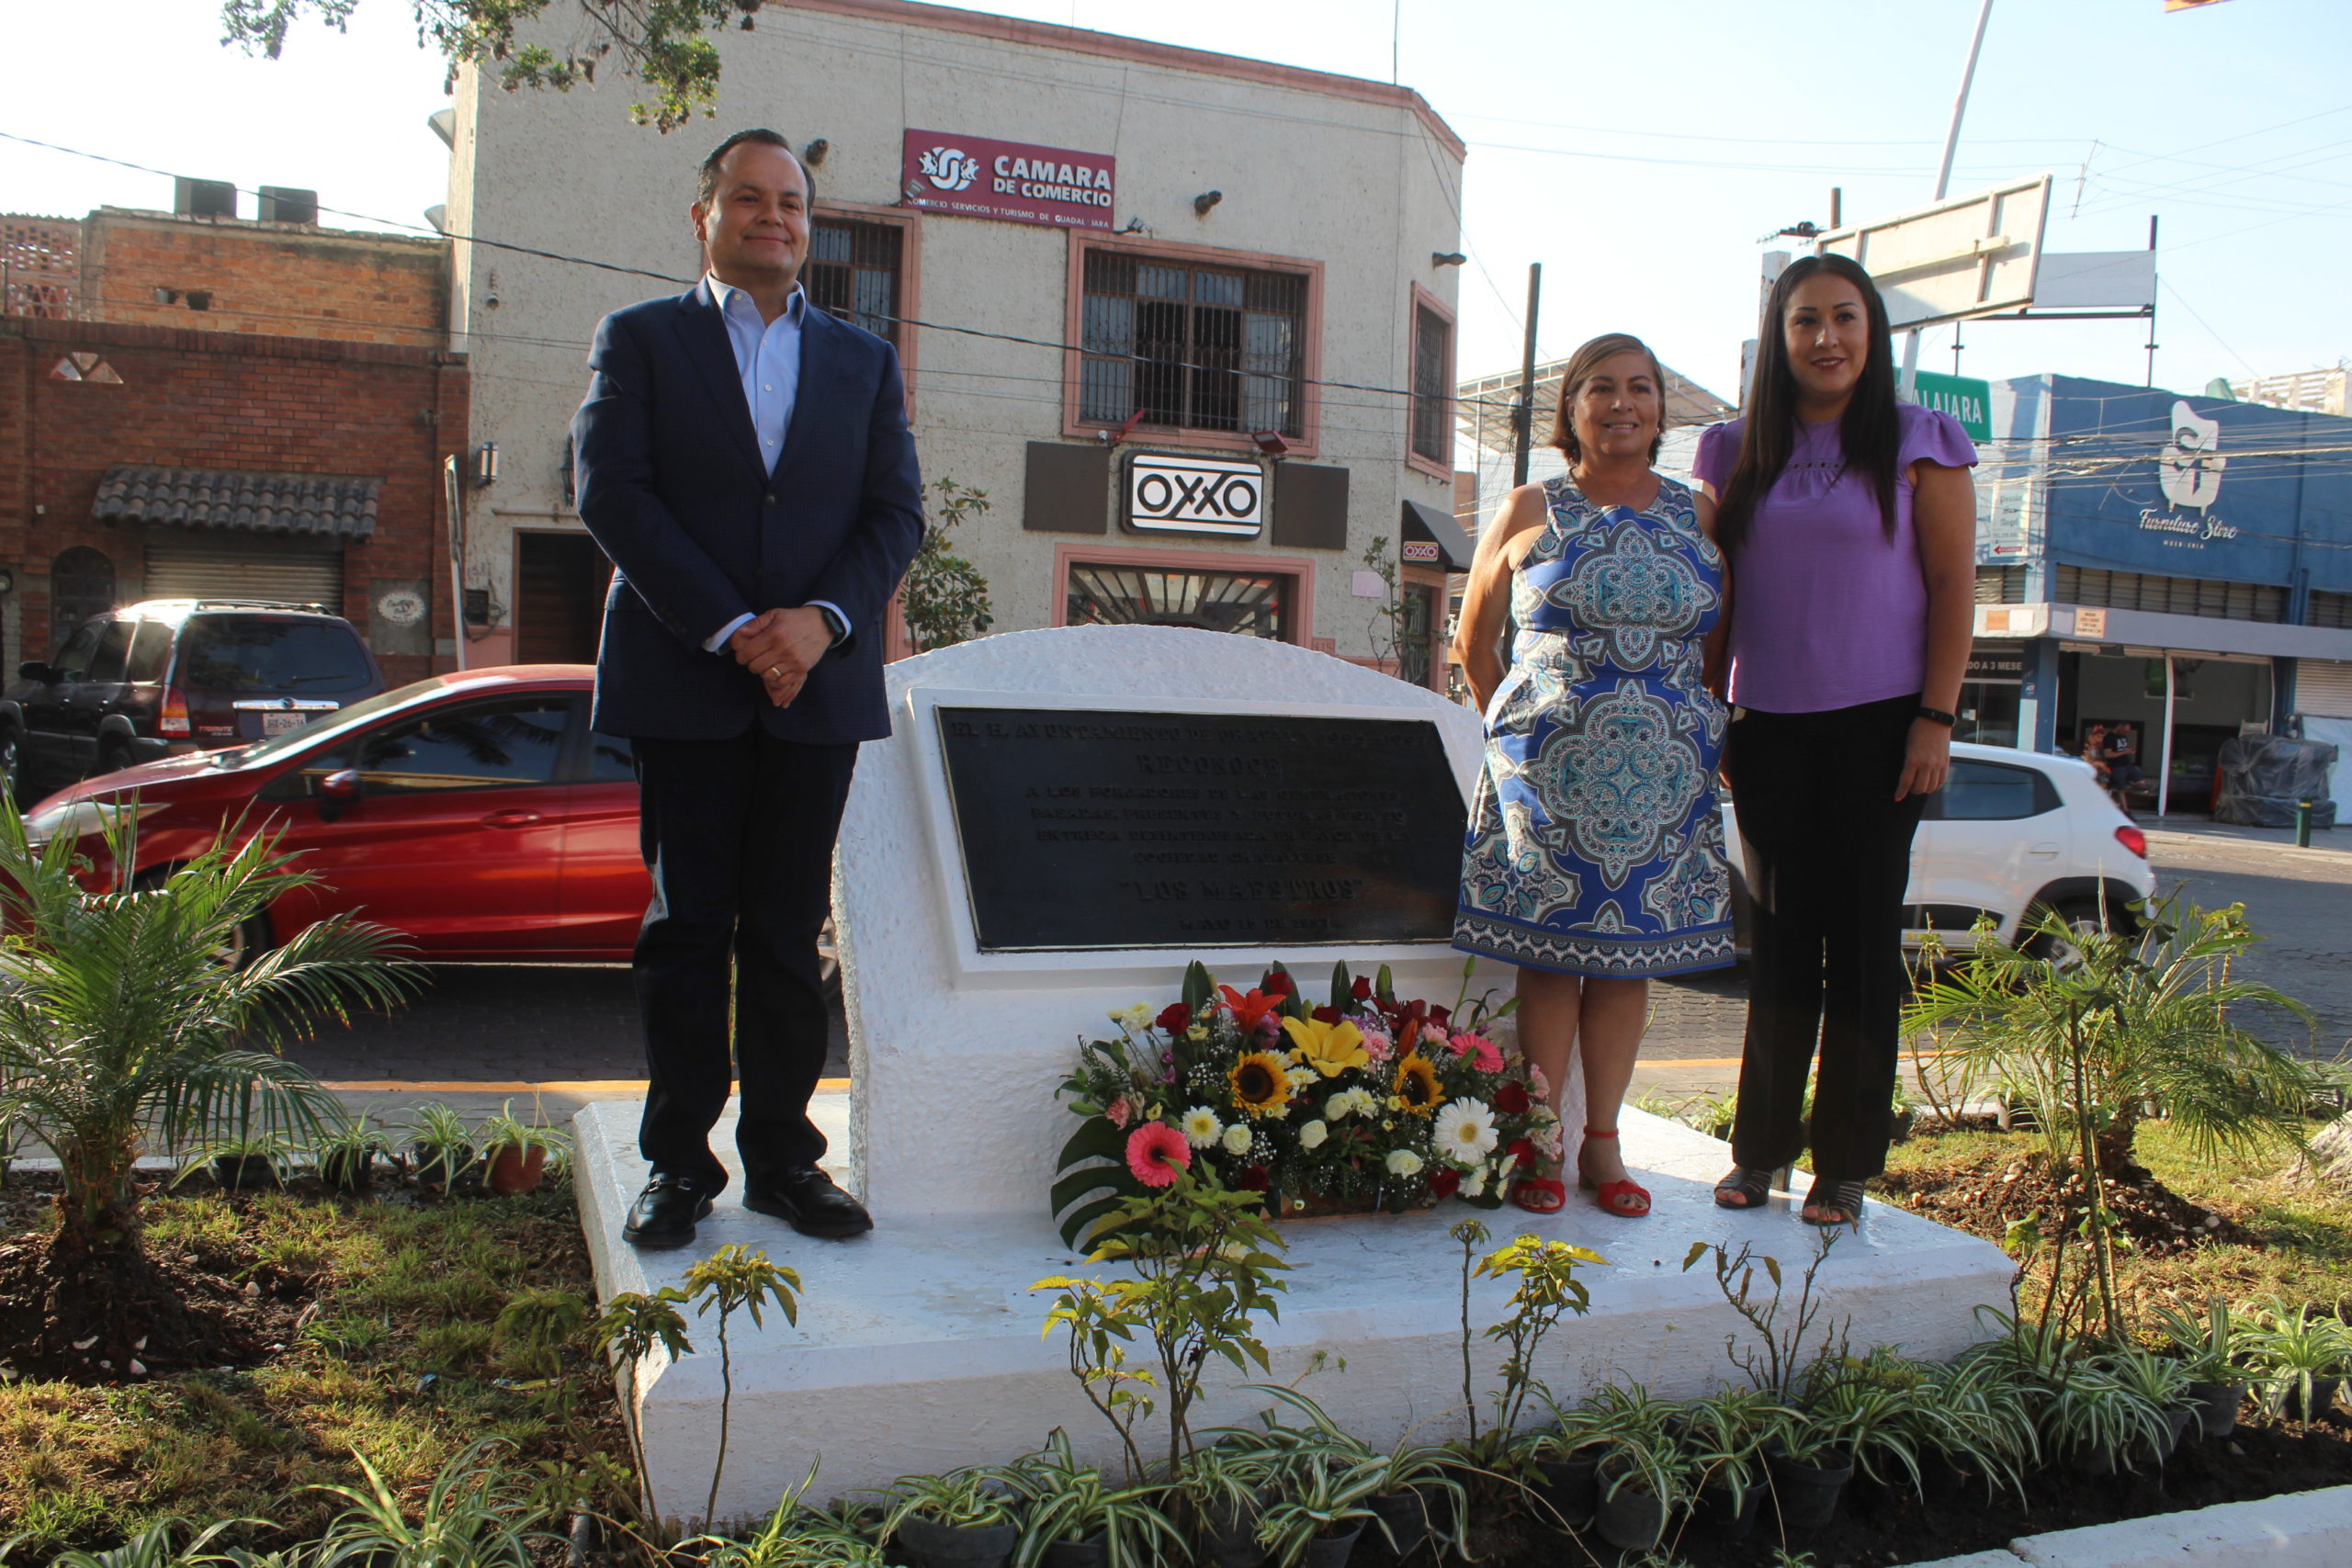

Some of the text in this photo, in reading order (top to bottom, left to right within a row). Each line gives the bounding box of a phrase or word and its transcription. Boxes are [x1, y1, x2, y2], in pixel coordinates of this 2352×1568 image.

[993, 154, 1112, 191] CAMARA
[993, 177, 1112, 208] DE COMERCIO
[951, 202, 990, 214] SERVICIOS
[993, 207, 999, 215] Y
[1001, 208, 1035, 220] TURISMO
[1039, 212, 1049, 221] DE
[1137, 473, 1258, 518] OXXO
[2139, 508, 2238, 540] Furniture Store
[1405, 546, 1437, 557] OXXO
[2163, 539, 2205, 549] MUEBERIA
[1982, 661, 1988, 670] A
[1990, 661, 1996, 670] 3
[1136, 753, 1281, 776] RECONOCE
[1024, 786, 1040, 798] A
[1046, 786, 1081, 798] LOS
[1208, 787, 1228, 799] DE
